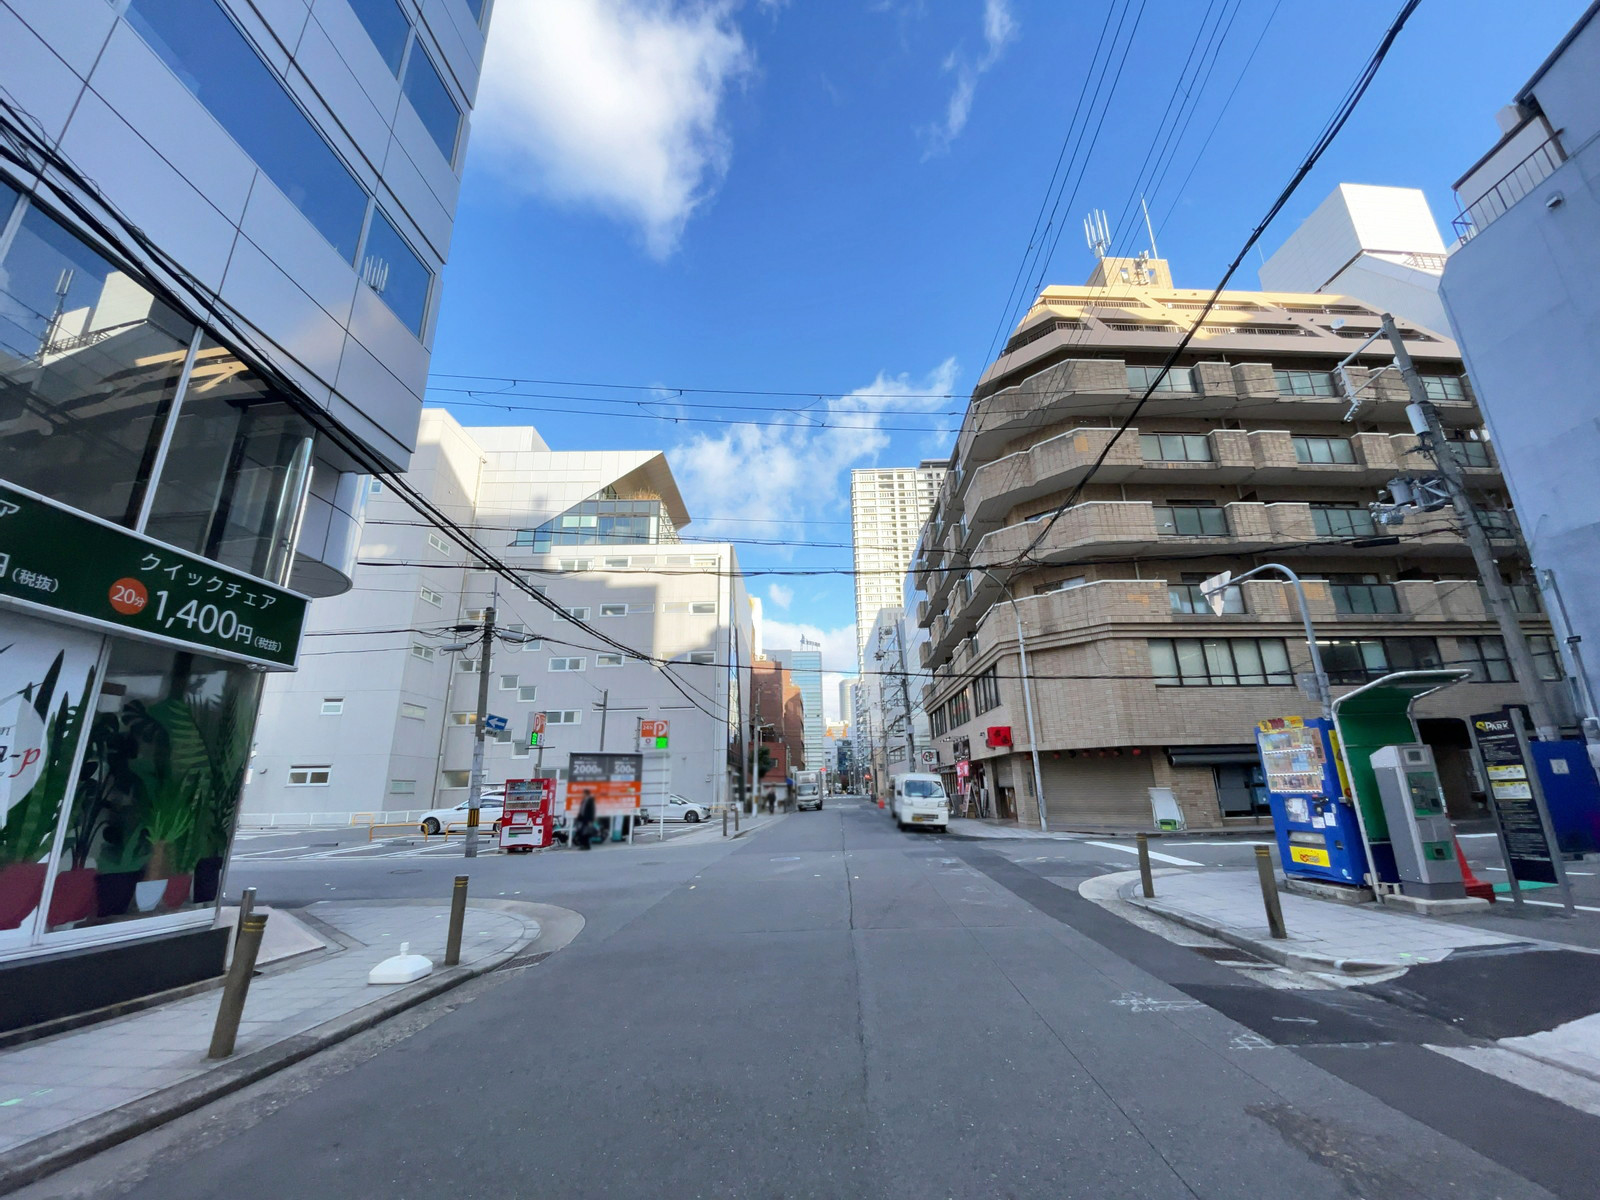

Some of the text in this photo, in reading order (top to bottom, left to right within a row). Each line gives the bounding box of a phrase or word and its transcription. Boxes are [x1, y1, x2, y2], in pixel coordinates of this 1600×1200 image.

[112, 585, 145, 607] 20分
[141, 553, 277, 609] クイックチェア
